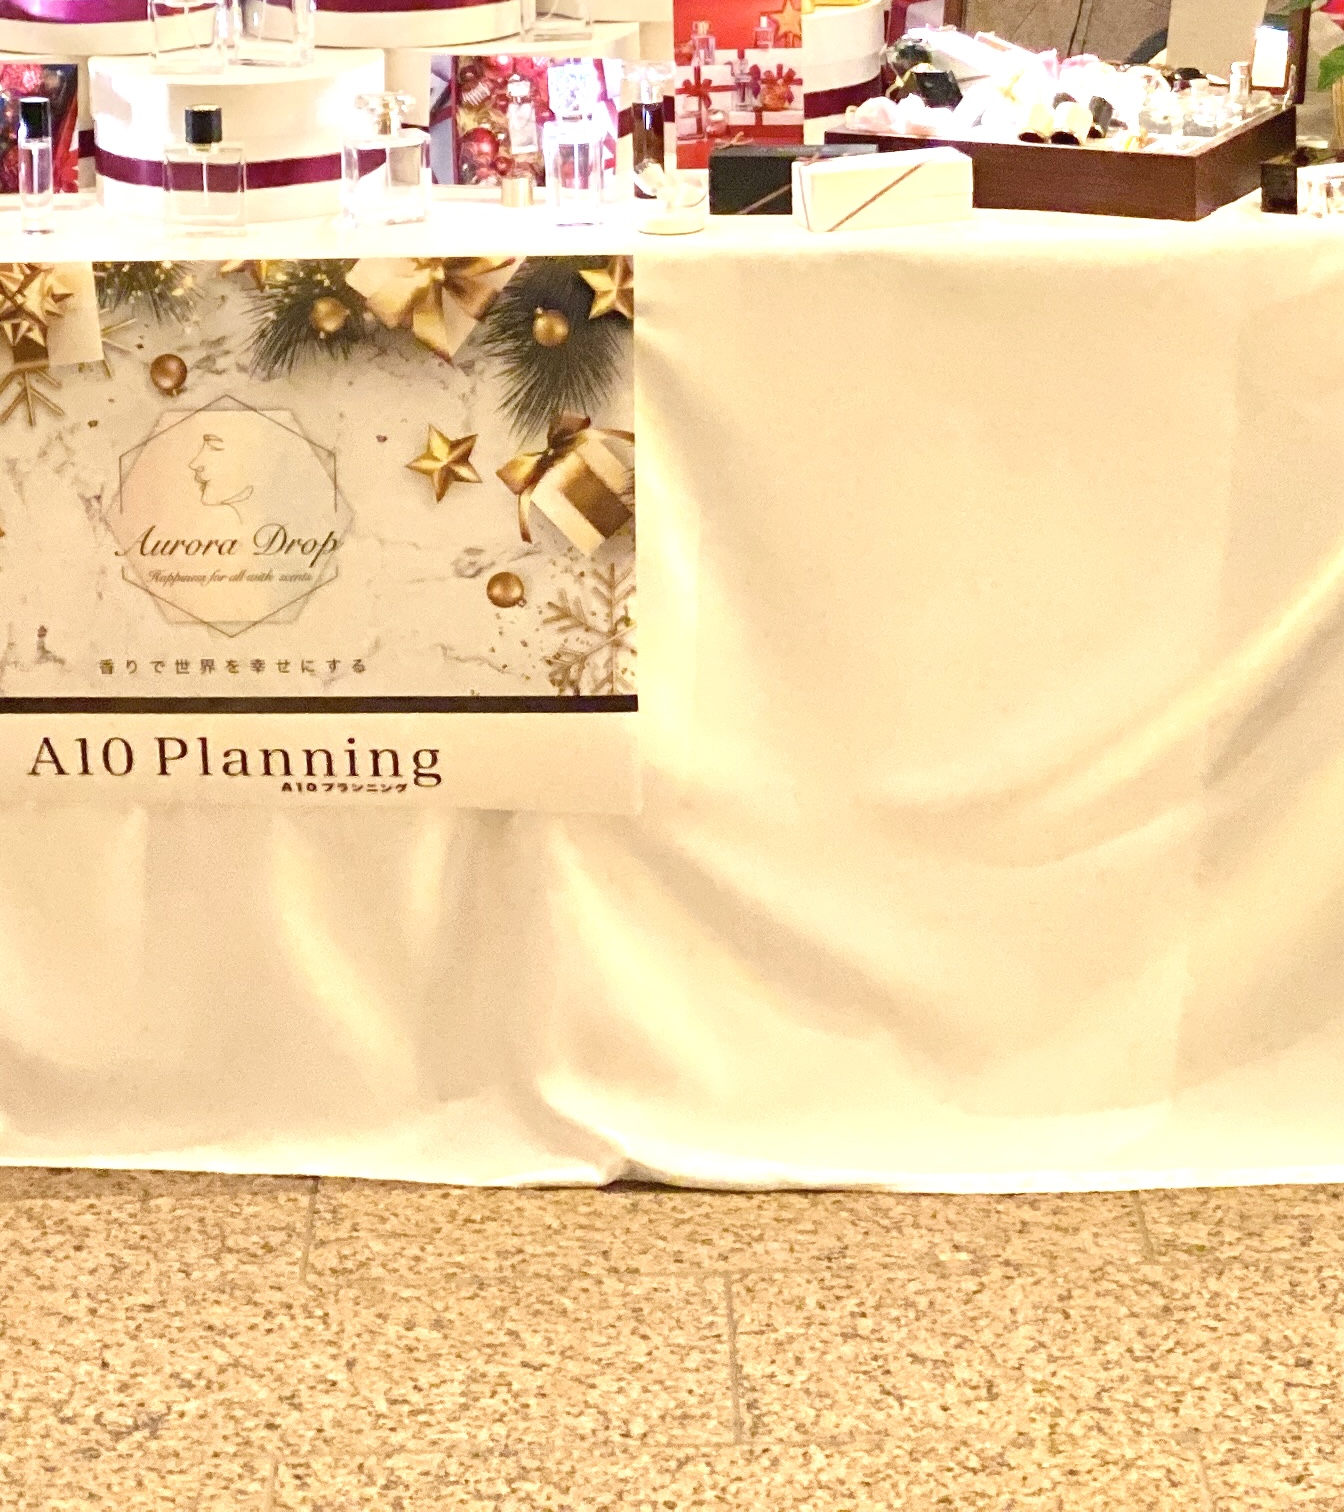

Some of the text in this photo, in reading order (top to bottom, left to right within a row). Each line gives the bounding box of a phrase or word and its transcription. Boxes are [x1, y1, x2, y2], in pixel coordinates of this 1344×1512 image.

[114, 523, 344, 568] Aurora Drop
[148, 569, 206, 587] Happiness
[204, 569, 227, 586] for
[229, 569, 245, 583] all
[246, 569, 273, 583] with
[99, 658, 367, 675] 香りで世界を幸せにする
[27, 736, 443, 788] A10 Planning
